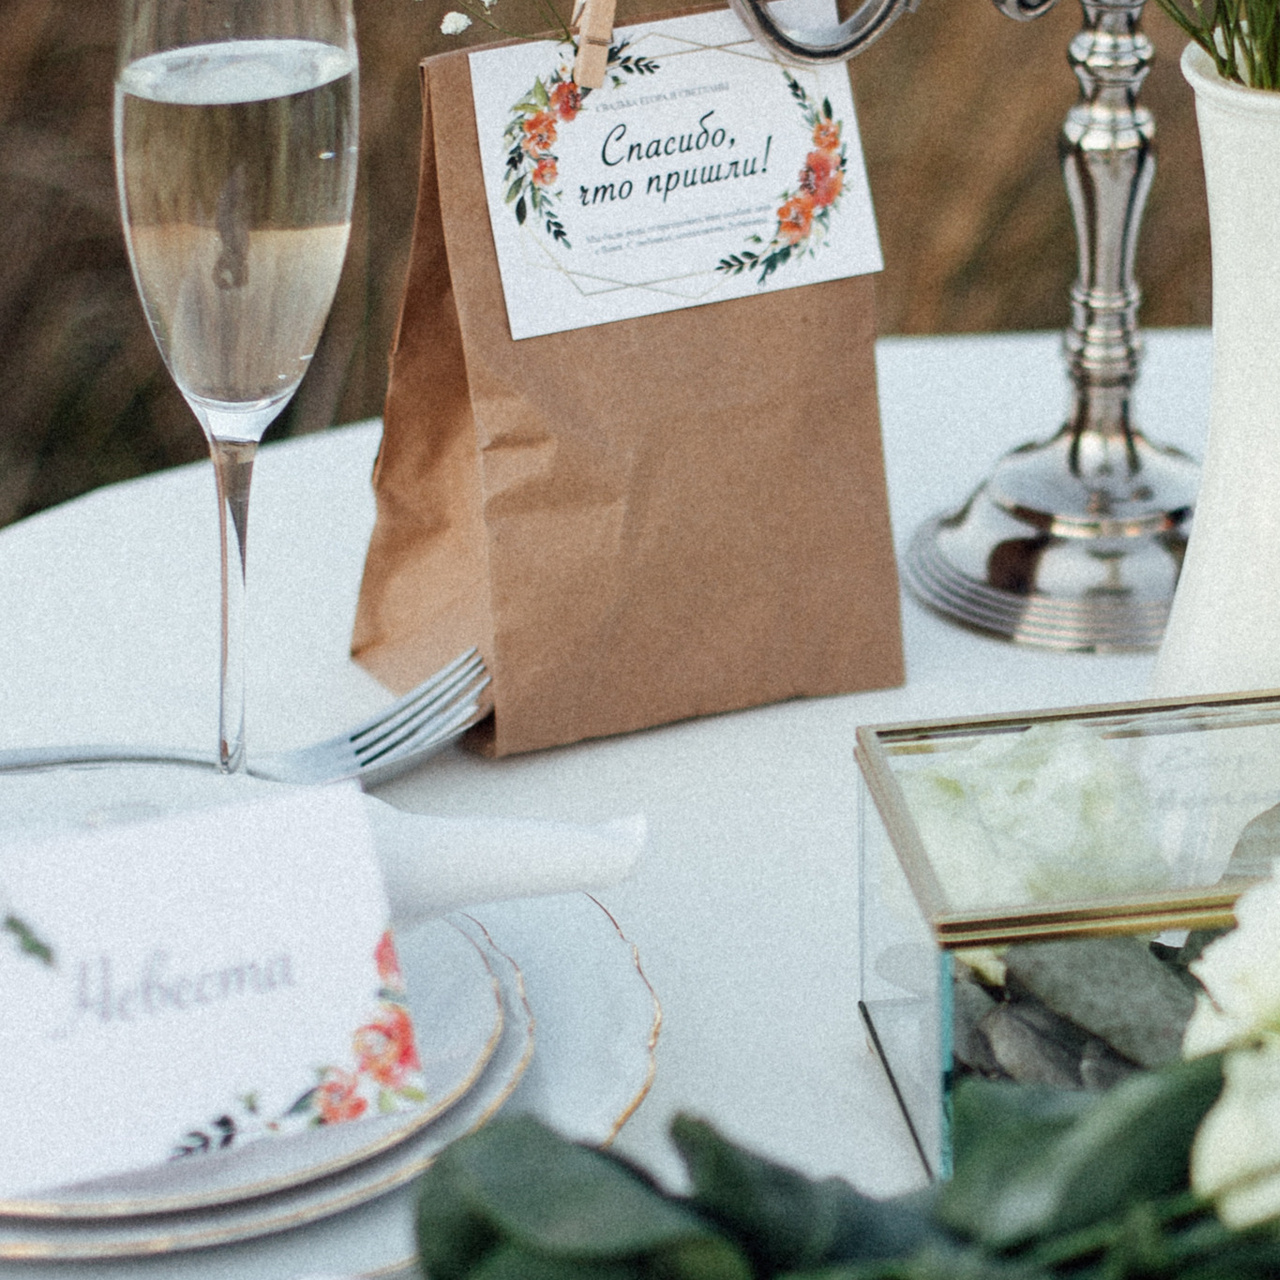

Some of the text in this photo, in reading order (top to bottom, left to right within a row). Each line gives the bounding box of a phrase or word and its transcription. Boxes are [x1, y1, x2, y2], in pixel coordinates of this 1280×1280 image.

[601, 110, 736, 166] Спасибо,
[579, 135, 773, 206] что пришли!
